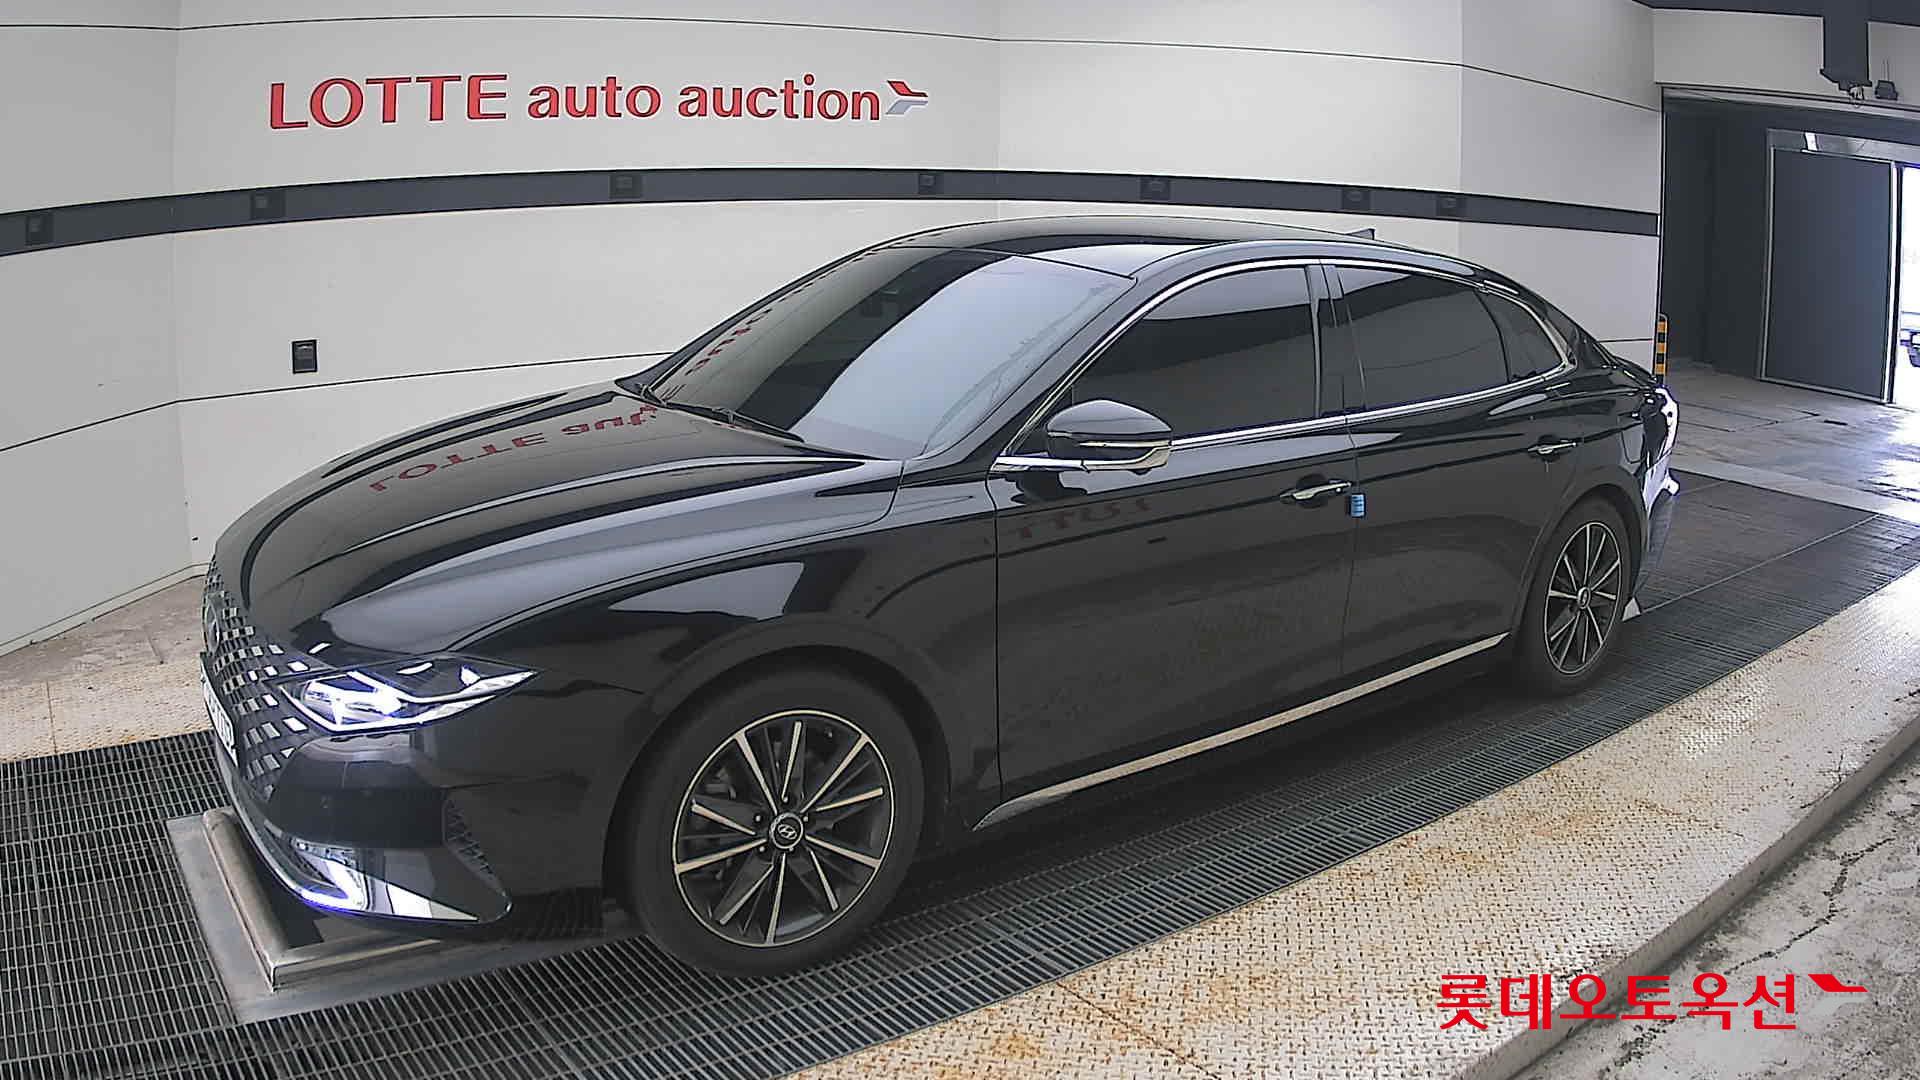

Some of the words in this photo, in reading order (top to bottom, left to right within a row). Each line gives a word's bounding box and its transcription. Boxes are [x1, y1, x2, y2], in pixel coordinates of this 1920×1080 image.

[269, 74, 508, 130] LOTTE
[527, 76, 662, 119] auto
[678, 74, 881, 121] auction
